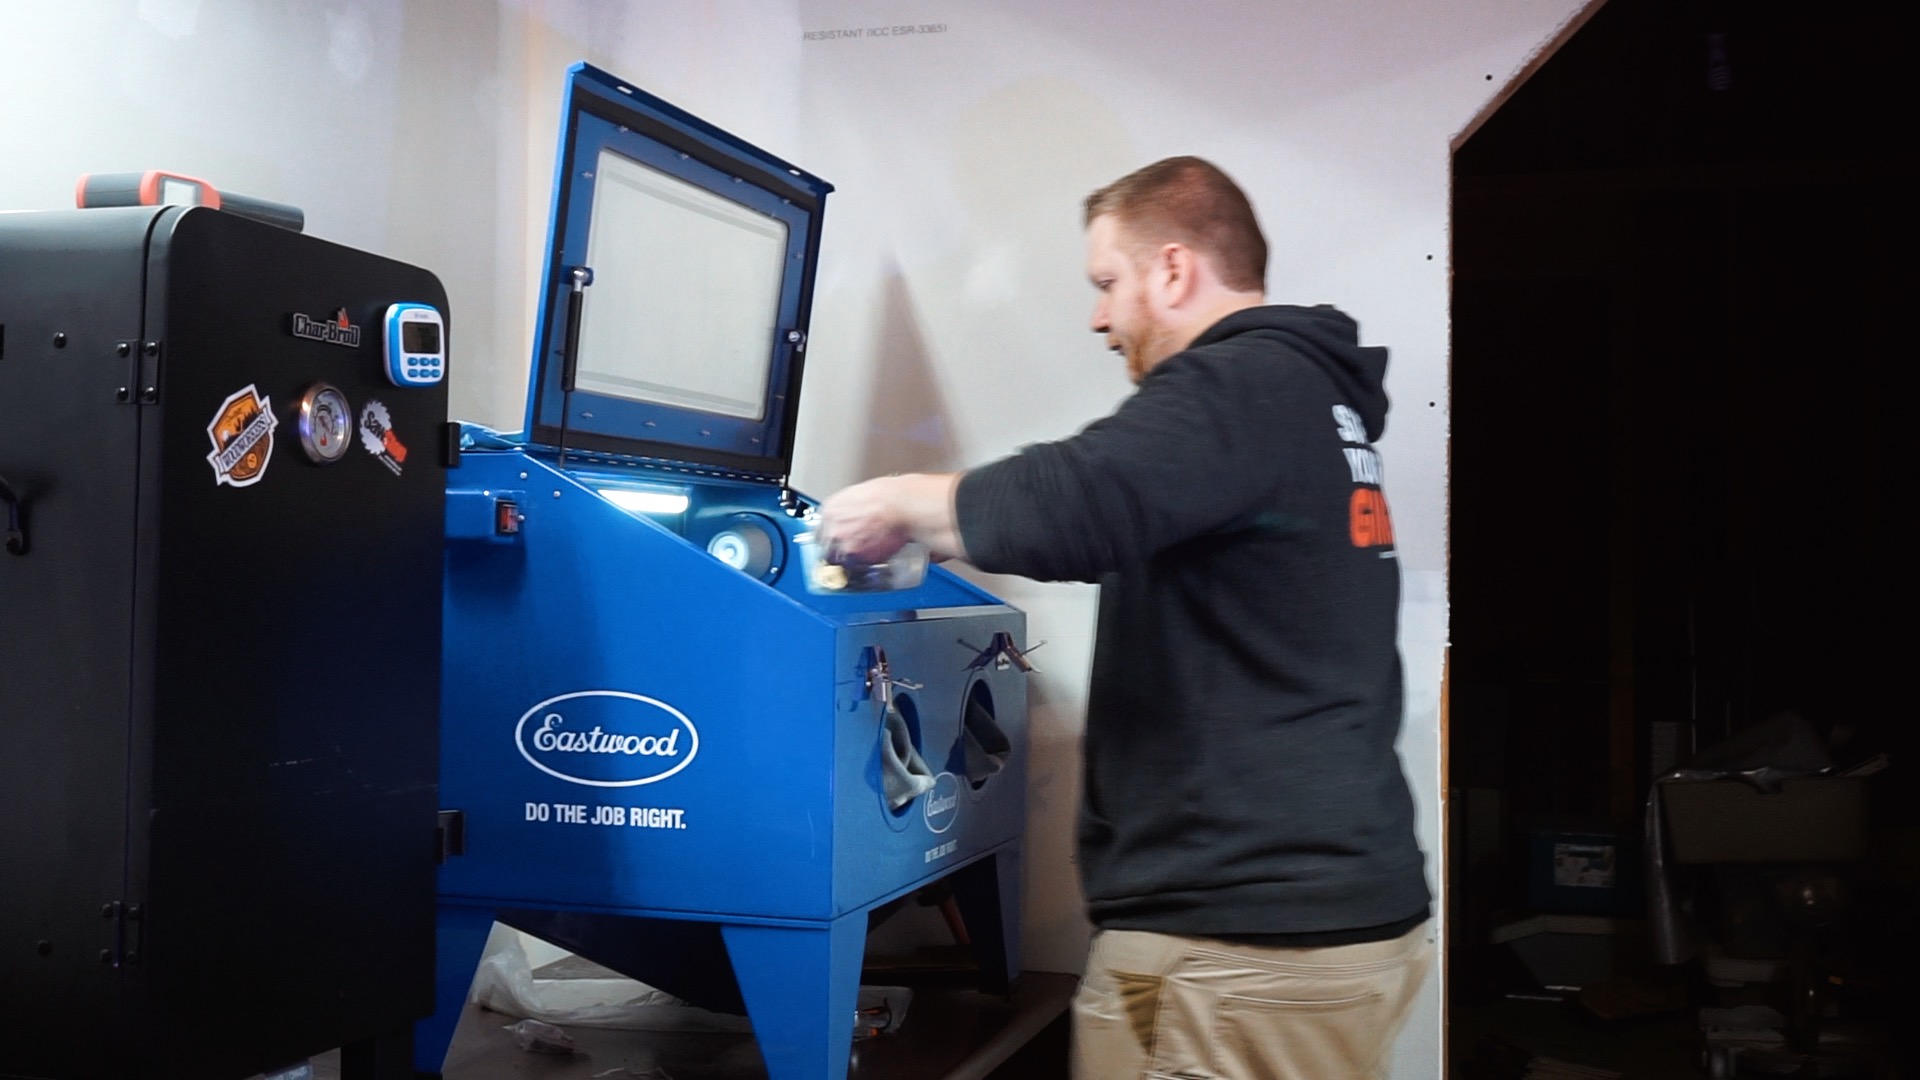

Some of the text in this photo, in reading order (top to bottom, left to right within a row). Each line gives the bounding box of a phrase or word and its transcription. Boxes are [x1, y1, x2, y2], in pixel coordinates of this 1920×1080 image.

[802, 28, 863, 40] RESISTANT
[533, 713, 680, 756] Eastwood
[525, 802, 687, 829] DO THE JOB RIGHT.
